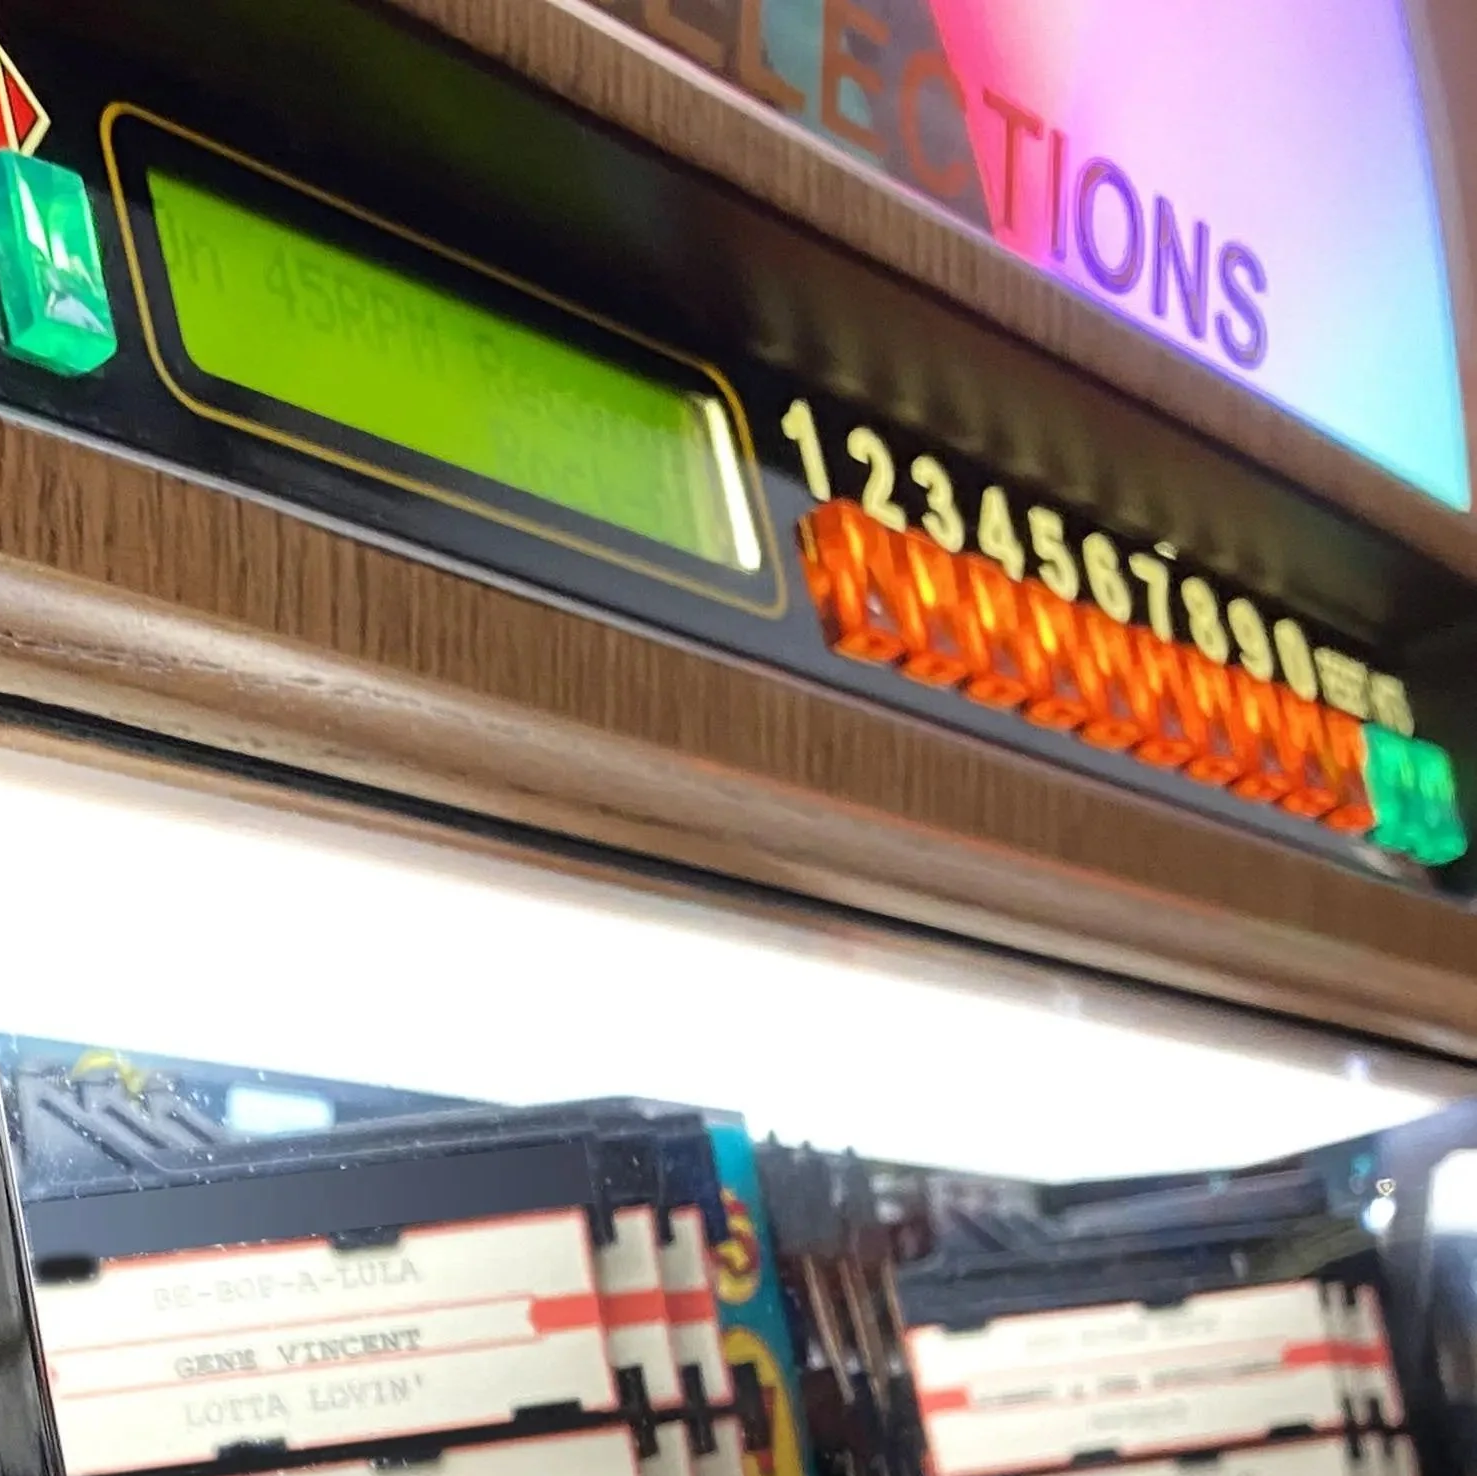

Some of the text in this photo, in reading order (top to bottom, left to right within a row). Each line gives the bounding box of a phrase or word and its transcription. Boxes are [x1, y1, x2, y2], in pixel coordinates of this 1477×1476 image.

[645, 0, 1268, 370] LECTIONS
[173, 1327, 422, 1380] GENE VINCENT
[183, 1371, 424, 1428] LOTTA LOVIN'
